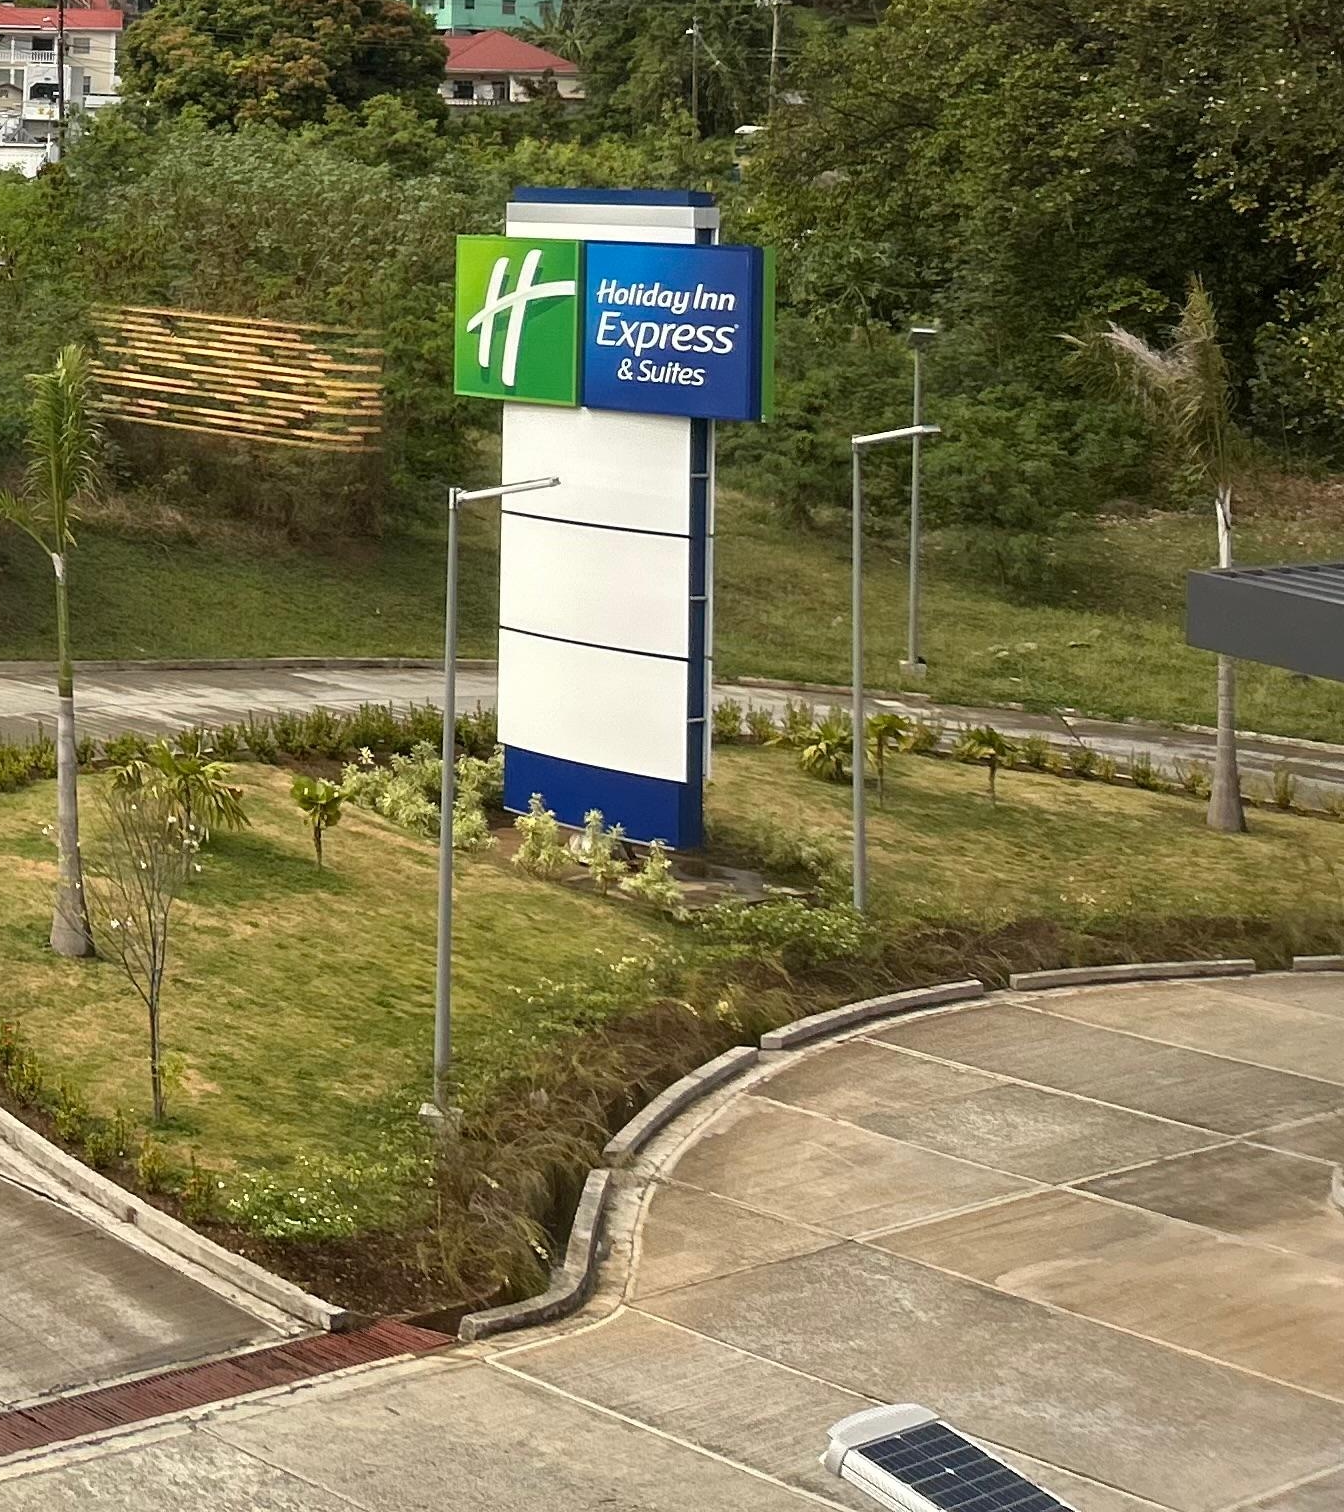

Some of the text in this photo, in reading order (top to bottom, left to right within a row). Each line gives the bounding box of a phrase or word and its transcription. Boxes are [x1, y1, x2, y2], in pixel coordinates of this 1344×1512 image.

[596, 278, 736, 315] Holiday Inn
[596, 311, 736, 356] Express
[617, 358, 705, 386] & Suites
